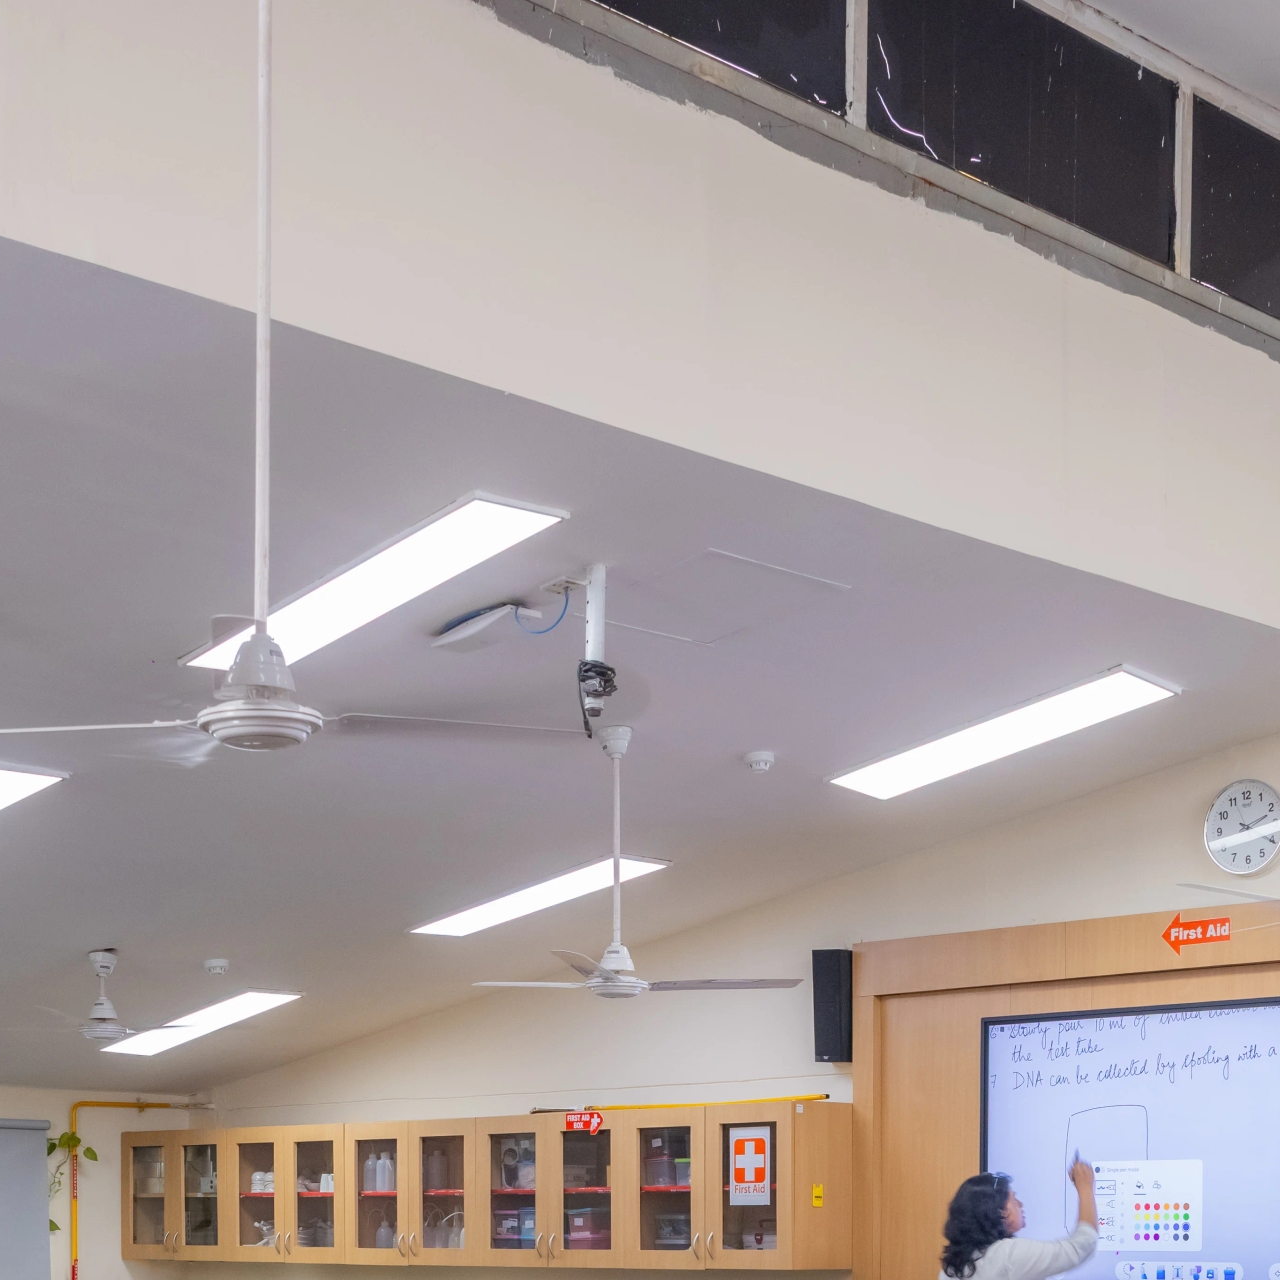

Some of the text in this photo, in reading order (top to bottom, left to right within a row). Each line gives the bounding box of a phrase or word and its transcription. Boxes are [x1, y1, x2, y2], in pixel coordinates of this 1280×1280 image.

[1241, 790, 1252, 801] 12
[1258, 792, 1263, 802] 1
[1228, 797, 1237, 807] 11
[1268, 802, 1275, 813] 2
[1218, 810, 1229, 821] 10
[1216, 827, 1223, 836] 9
[1231, 853, 1237, 863] 7
[1259, 848, 1265, 858] 5
[1245, 855, 1251, 864] 6
[1170, 922, 1230, 942] First Aid
[1058, 1020, 1084, 1045] pour
[1095, 1018, 1105, 1032] 10
[1133, 1013, 1150, 1041] of
[1011, 1038, 1105, 1063] the test tube
[990, 1074, 997, 1089] 7
[1013, 1070, 1044, 1091] DNA
[1049, 1074, 1070, 1087] can
[1076, 1065, 1090, 1085] be
[1096, 1059, 1150, 1083] collected
[1155, 1053, 1177, 1084] by
[1181, 1045, 1230, 1080] spooling
[1237, 1044, 1262, 1062] with
[1268, 1046, 1277, 1056] a
[566, 1113, 591, 1122] FIRST AID
[573, 1121, 584, 1129] BOX
[734, 1183, 766, 1194] First Aid
